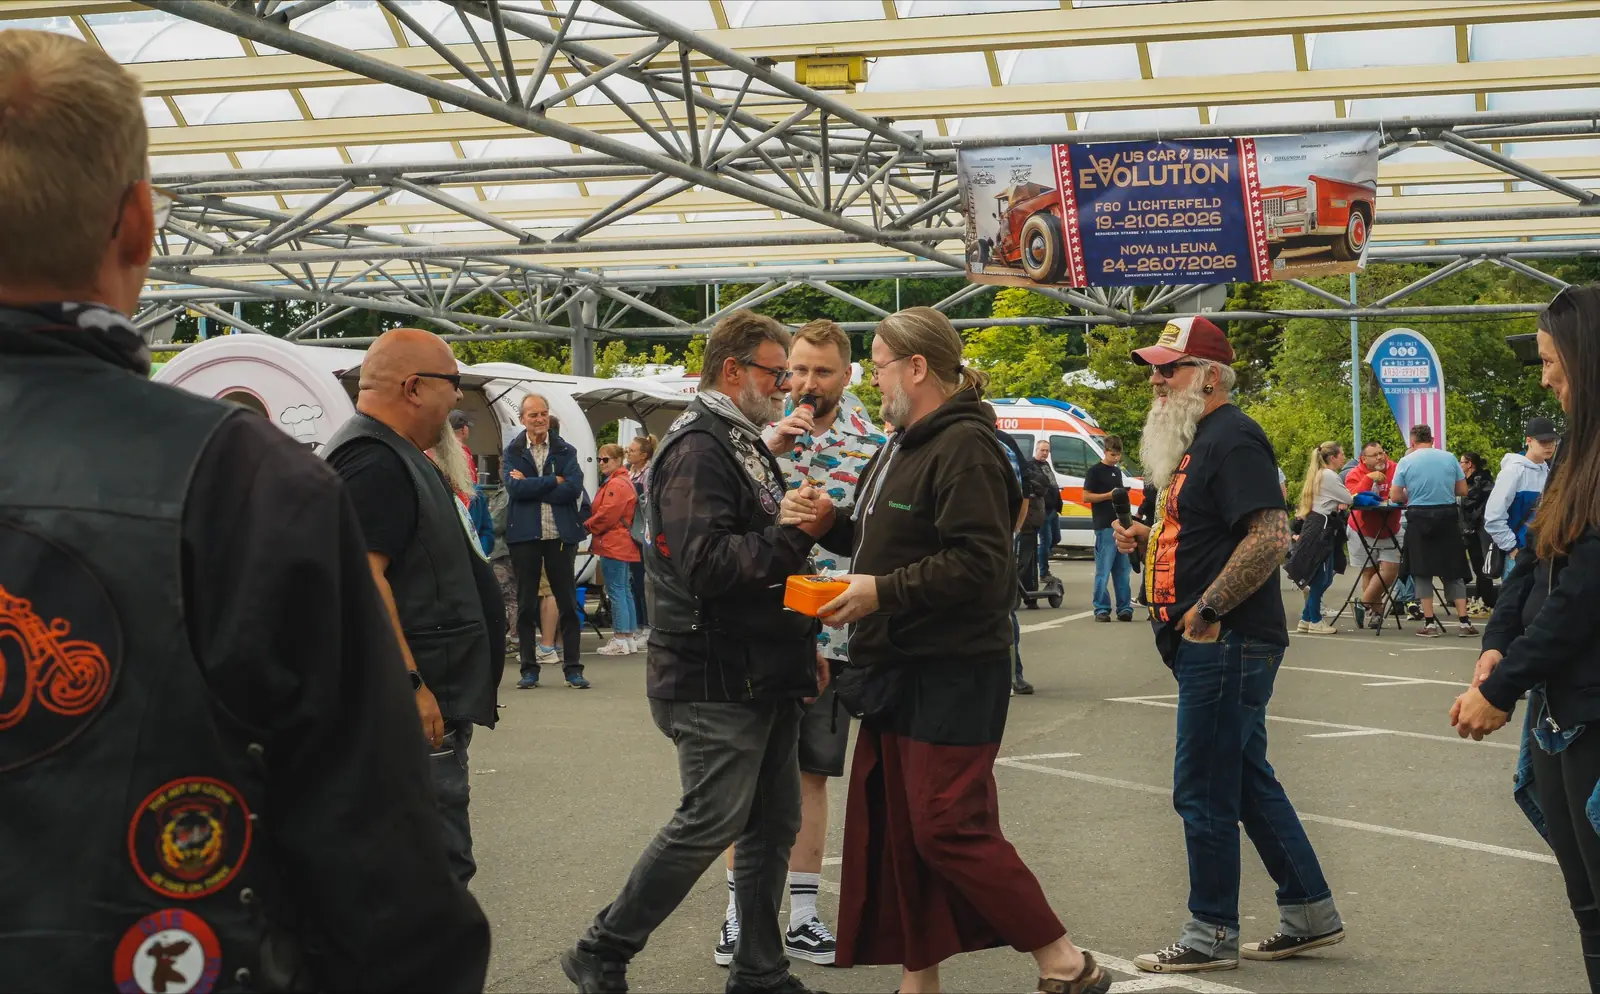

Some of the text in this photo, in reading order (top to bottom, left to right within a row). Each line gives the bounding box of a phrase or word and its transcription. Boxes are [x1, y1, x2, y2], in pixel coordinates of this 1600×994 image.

[1122, 148, 1229, 164] US CAR & BIKE
[1095, 198, 1222, 213] F60 LICHTERFELD
[1120, 244, 1155, 256] NOVA
[1171, 242, 1217, 254] LEUNA
